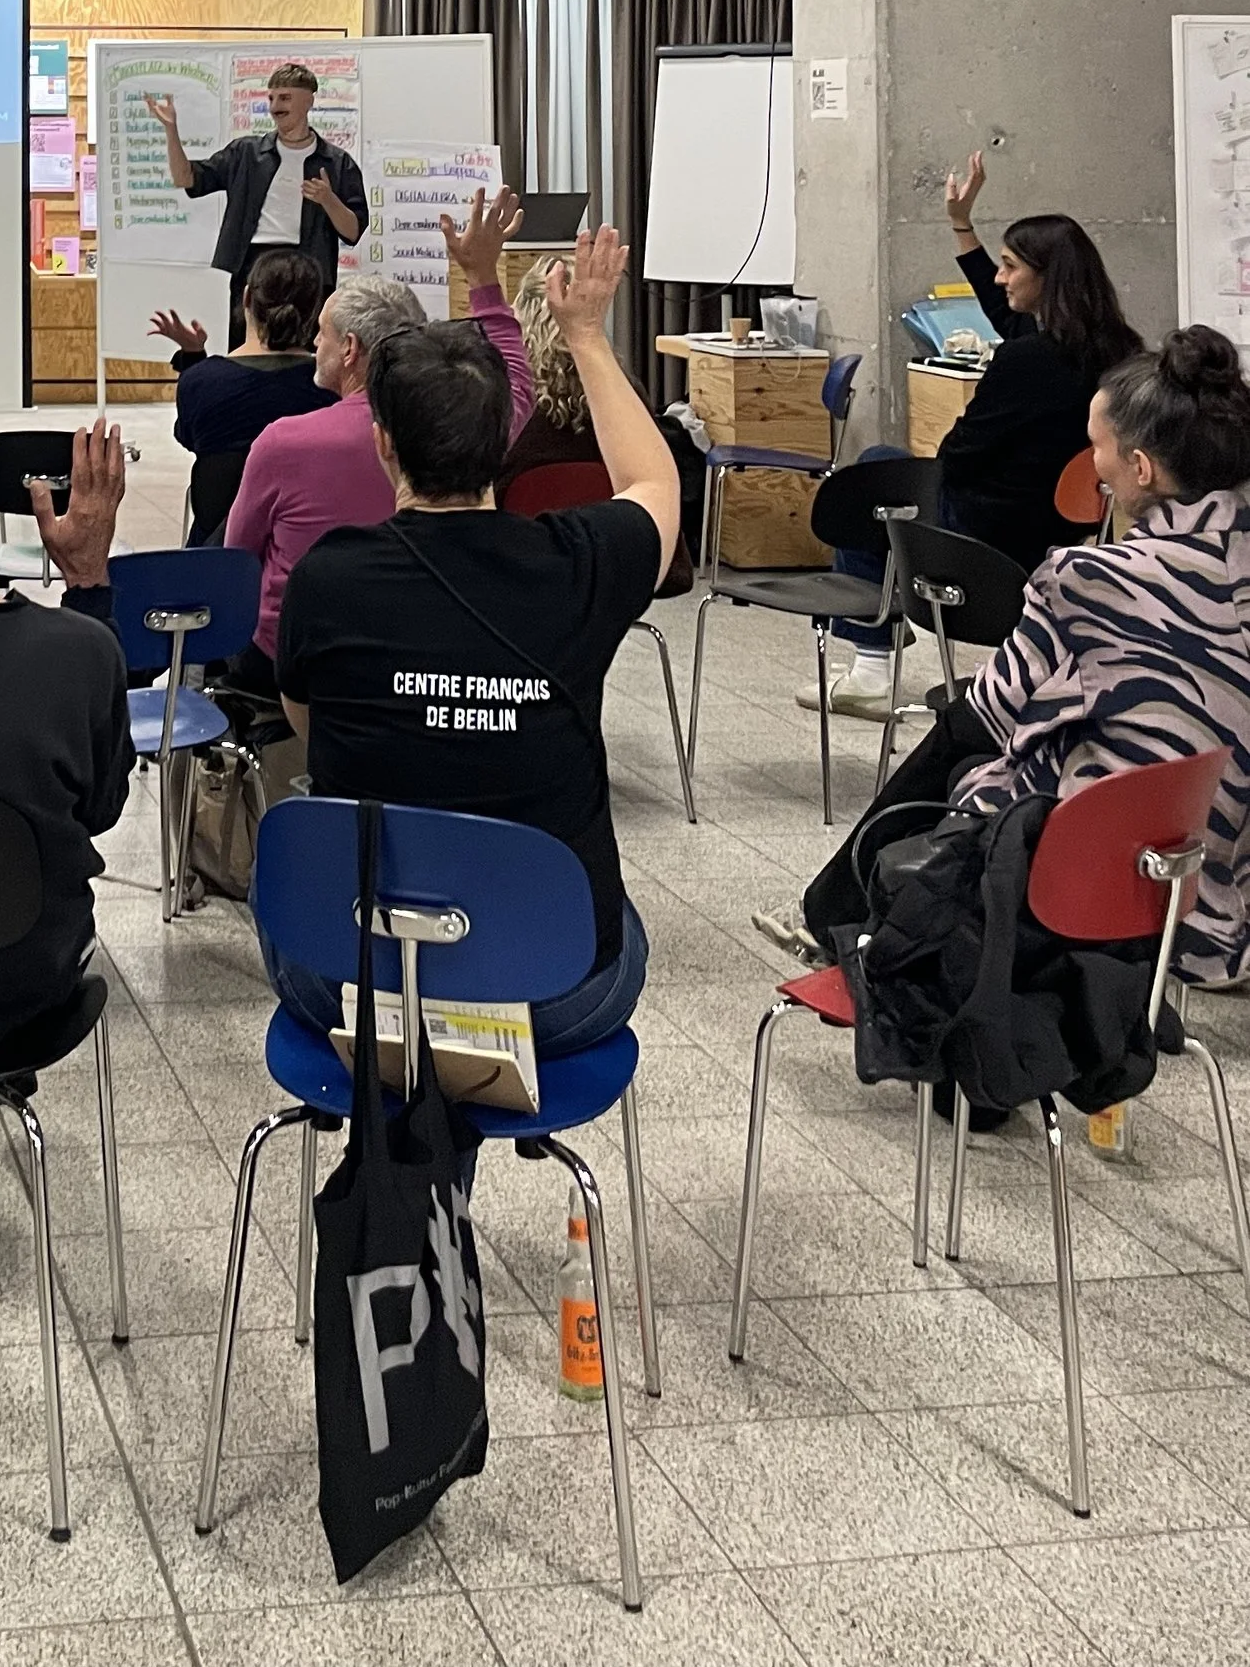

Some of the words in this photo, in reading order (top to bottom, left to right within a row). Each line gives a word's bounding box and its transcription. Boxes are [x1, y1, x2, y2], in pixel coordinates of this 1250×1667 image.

[393, 671, 461, 698] CENTRE
[466, 676, 551, 704] FRANÇAIS
[426, 705, 450, 728] DE
[454, 707, 517, 731] BERLIN
